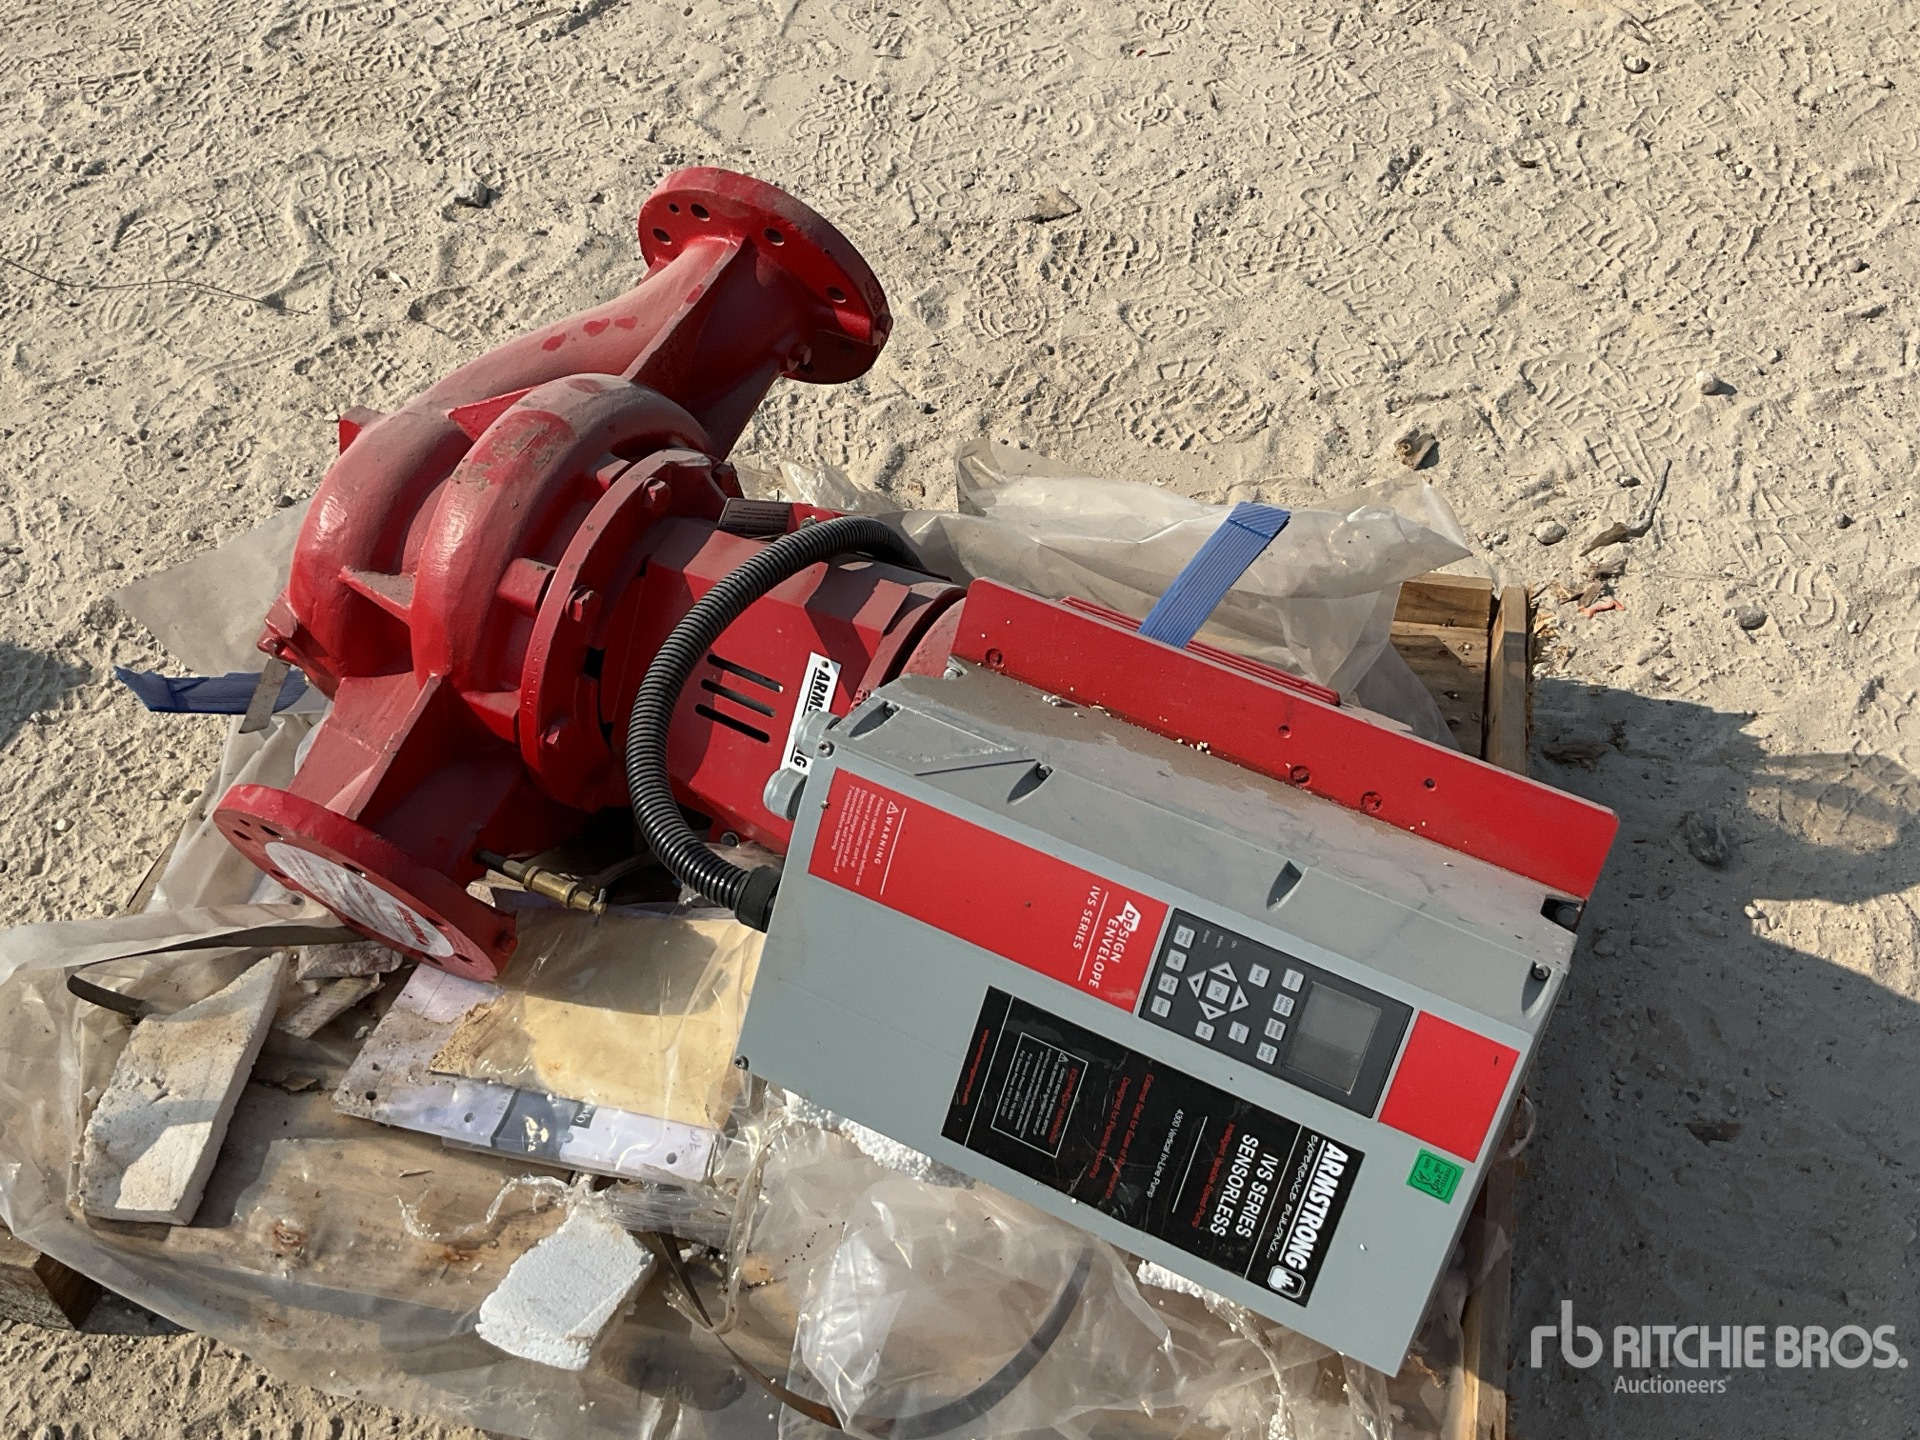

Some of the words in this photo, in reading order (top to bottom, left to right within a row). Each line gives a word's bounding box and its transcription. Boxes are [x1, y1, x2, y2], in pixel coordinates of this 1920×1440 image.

[842, 789, 853, 811] minutes
[844, 786, 861, 826] disconnection,
[855, 789, 867, 814] Electrical
[865, 793, 876, 813] Beware
[873, 796, 884, 817] Always
[837, 810, 847, 829] before
[849, 813, 859, 833] danger
[870, 816, 878, 831] read
[830, 828, 841, 850] opening
[841, 825, 850, 838] wait
[856, 820, 867, 847] automatic
[873, 816, 893, 864] WARNING
[834, 841, 845, 866] minimum
[843, 832, 853, 854] persists
[852, 846, 860, 860] start
[862, 839, 871, 859] manual
[832, 865, 838, 873] of
[840, 854, 848, 867] after
[849, 859, 856, 867] up
[857, 858, 866, 875] before
[1086, 885, 1101, 906] IVS
[1072, 908, 1093, 949] SERIES
[1109, 908, 1137, 963] DESIGN
[1087, 918, 1120, 988] ENVELOPE
[1213, 986, 1222, 997] OK
[1111, 1076, 1130, 1110] Designed
[1138, 1073, 1154, 1103] External
[1109, 1109, 1119, 1120] for
[1132, 1102, 1144, 1119] Seal
[1171, 1108, 1184, 1127] 4300
[1099, 1119, 1116, 1147] Pipeline
[1128, 1118, 1138, 1130] for
[1122, 1129, 1135, 1148] Ease
[1162, 1127, 1178, 1153] Vertical
[1217, 1122, 1235, 1156] Intelligent
[1088, 1147, 1106, 1179] Mounting
[1119, 1147, 1127, 1157] of
[1153, 1152, 1169, 1177] In-Line
[1207, 1156, 1223, 1184] Variable
[1255, 1152, 1278, 1180] IVS
[1287, 1134, 1318, 1201] EXPERIENCE
[1145, 1176, 1160, 1198] Pump
[1209, 1133, 1259, 1236] SENSORLESS
[1198, 1183, 1213, 1209] Speed
[1283, 1142, 1349, 1270] ARMSTRONG
[1190, 1207, 1205, 1228] Pump
[1234, 1180, 1268, 1237] SERIES
